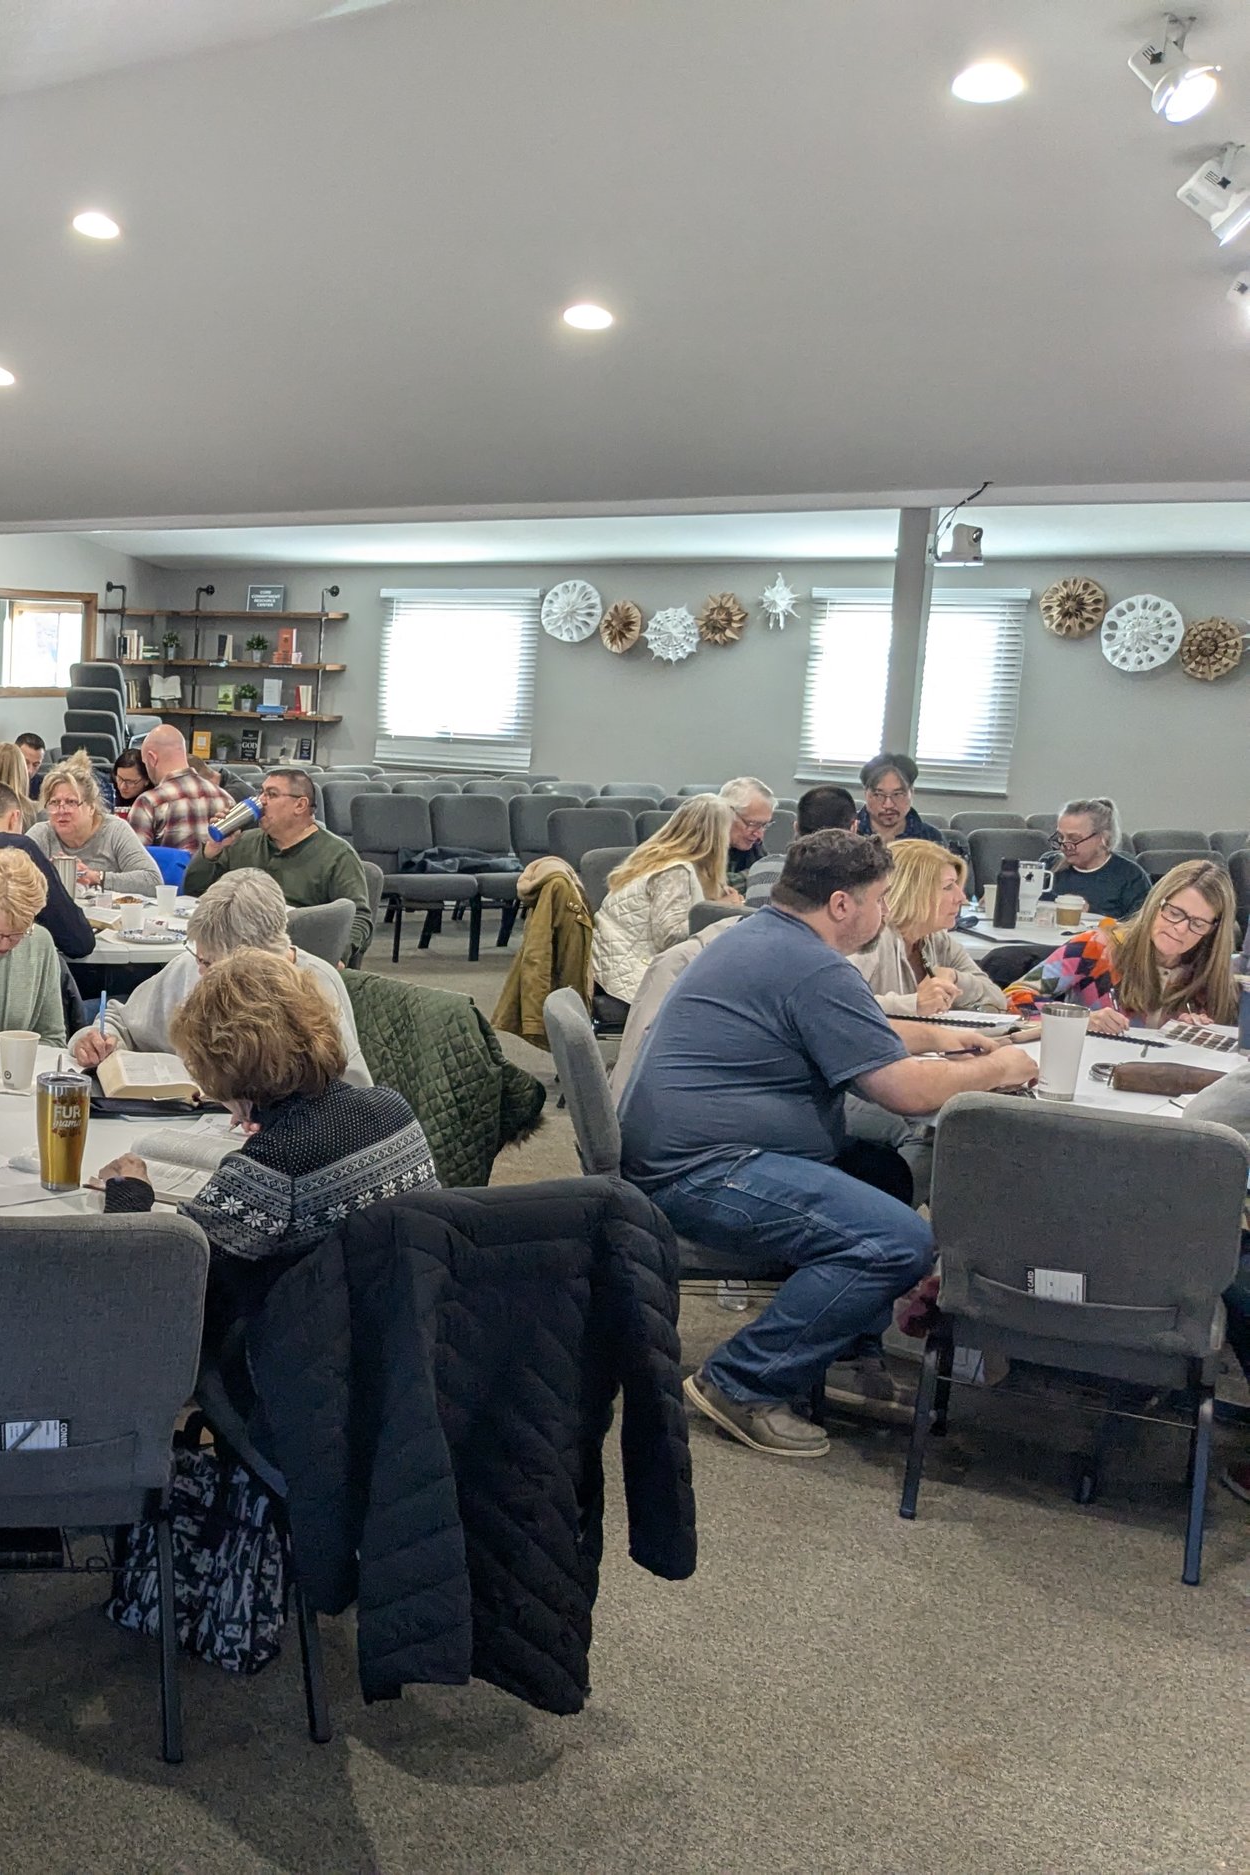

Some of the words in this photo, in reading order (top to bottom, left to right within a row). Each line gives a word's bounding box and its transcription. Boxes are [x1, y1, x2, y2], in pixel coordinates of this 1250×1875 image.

[241, 741, 258, 749] GOD
[53, 1105, 81, 1119] FUR
[52, 1119, 82, 1128] mama
